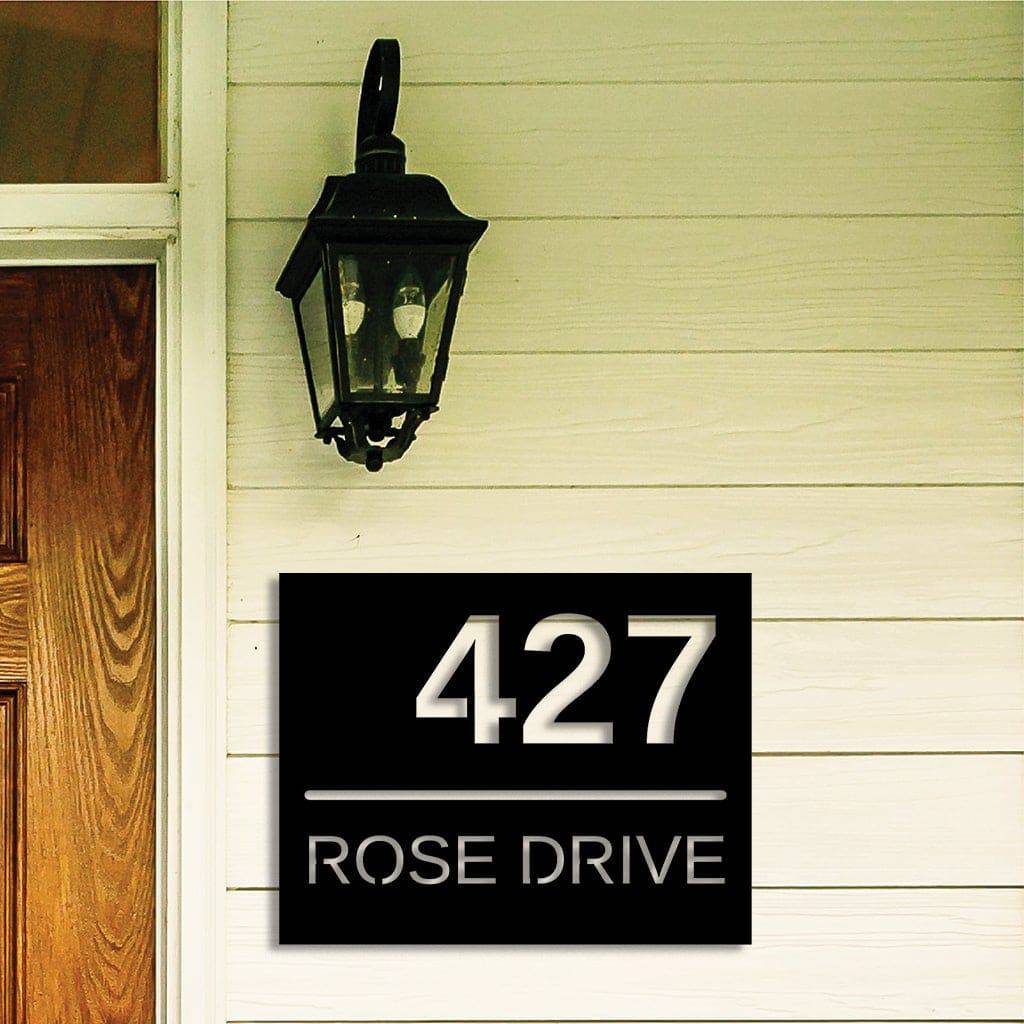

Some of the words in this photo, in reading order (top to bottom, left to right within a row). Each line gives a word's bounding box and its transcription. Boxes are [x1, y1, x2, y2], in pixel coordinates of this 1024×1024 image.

[416, 613, 716, 744] 427
[308, 834, 496, 885] ROSE
[523, 834, 725, 885] DRIVE
